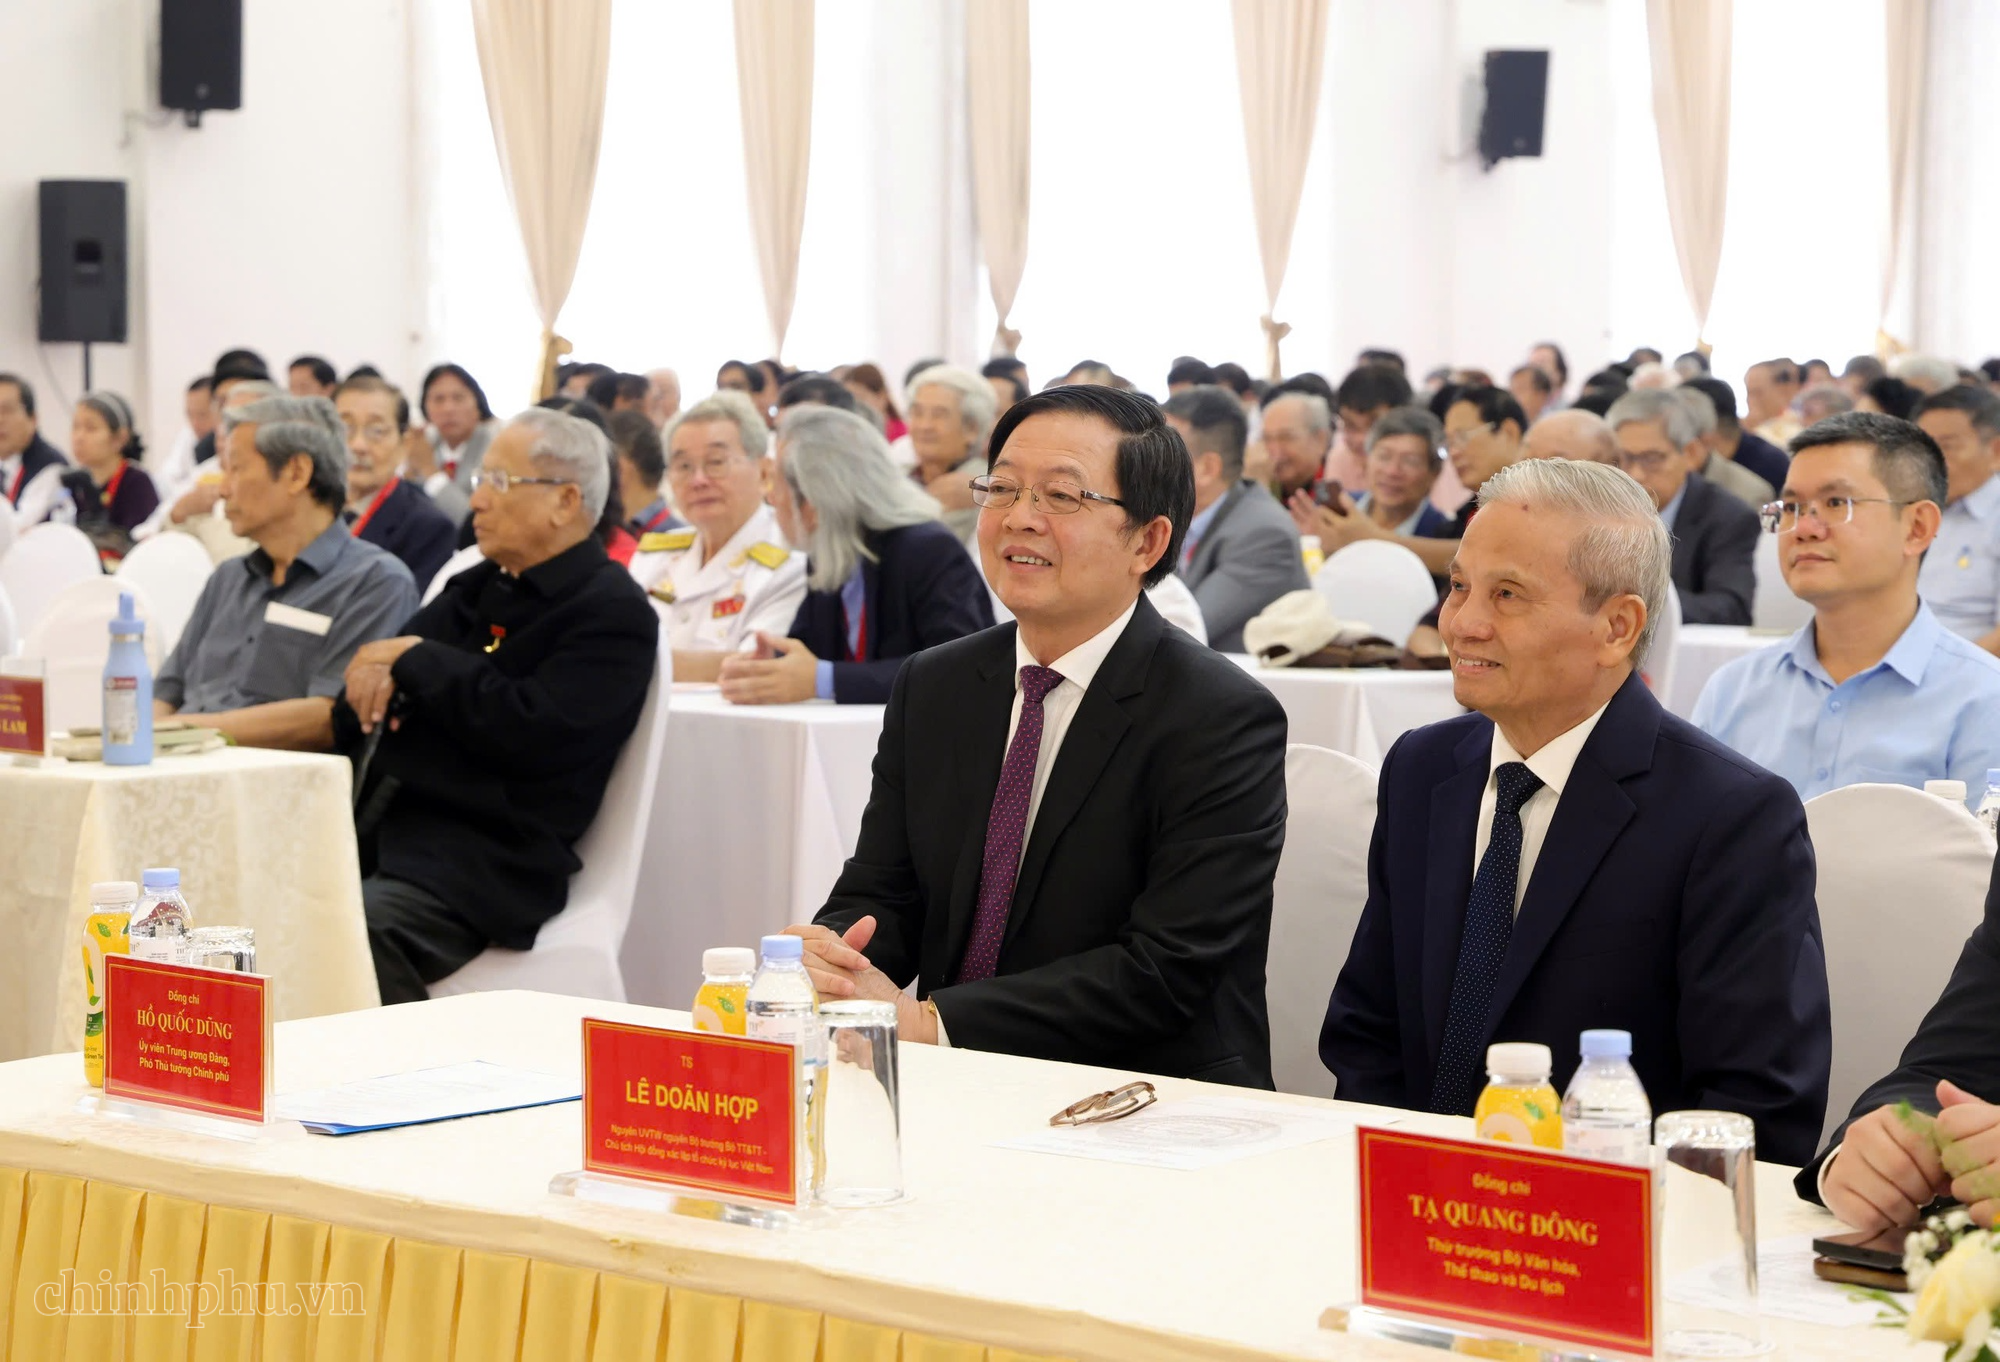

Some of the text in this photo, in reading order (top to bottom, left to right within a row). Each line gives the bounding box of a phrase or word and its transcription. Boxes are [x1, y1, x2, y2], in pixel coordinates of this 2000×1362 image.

[168, 990, 200, 1005] Đồng chí
[137, 1003, 233, 1040] HỒ QUỐC DŨNG
[138, 1037, 230, 1067] Ủy viên Trung ương Đảng,
[681, 1055, 694, 1069] TS
[139, 1057, 230, 1083] Phó Thủ tướng Chính phủ
[626, 1077, 759, 1124] LÊ DOÃN HỢP
[1408, 1194, 1599, 1246] TẠ QUANG ĐÔNG
[1502, 1248, 1522, 1268] Bộ
[1469, 1265, 1499, 1285] thao
[1500, 1271, 1518, 1288] và
[1518, 1273, 1539, 1291] Du
[1540, 1278, 1565, 1296] lịch
